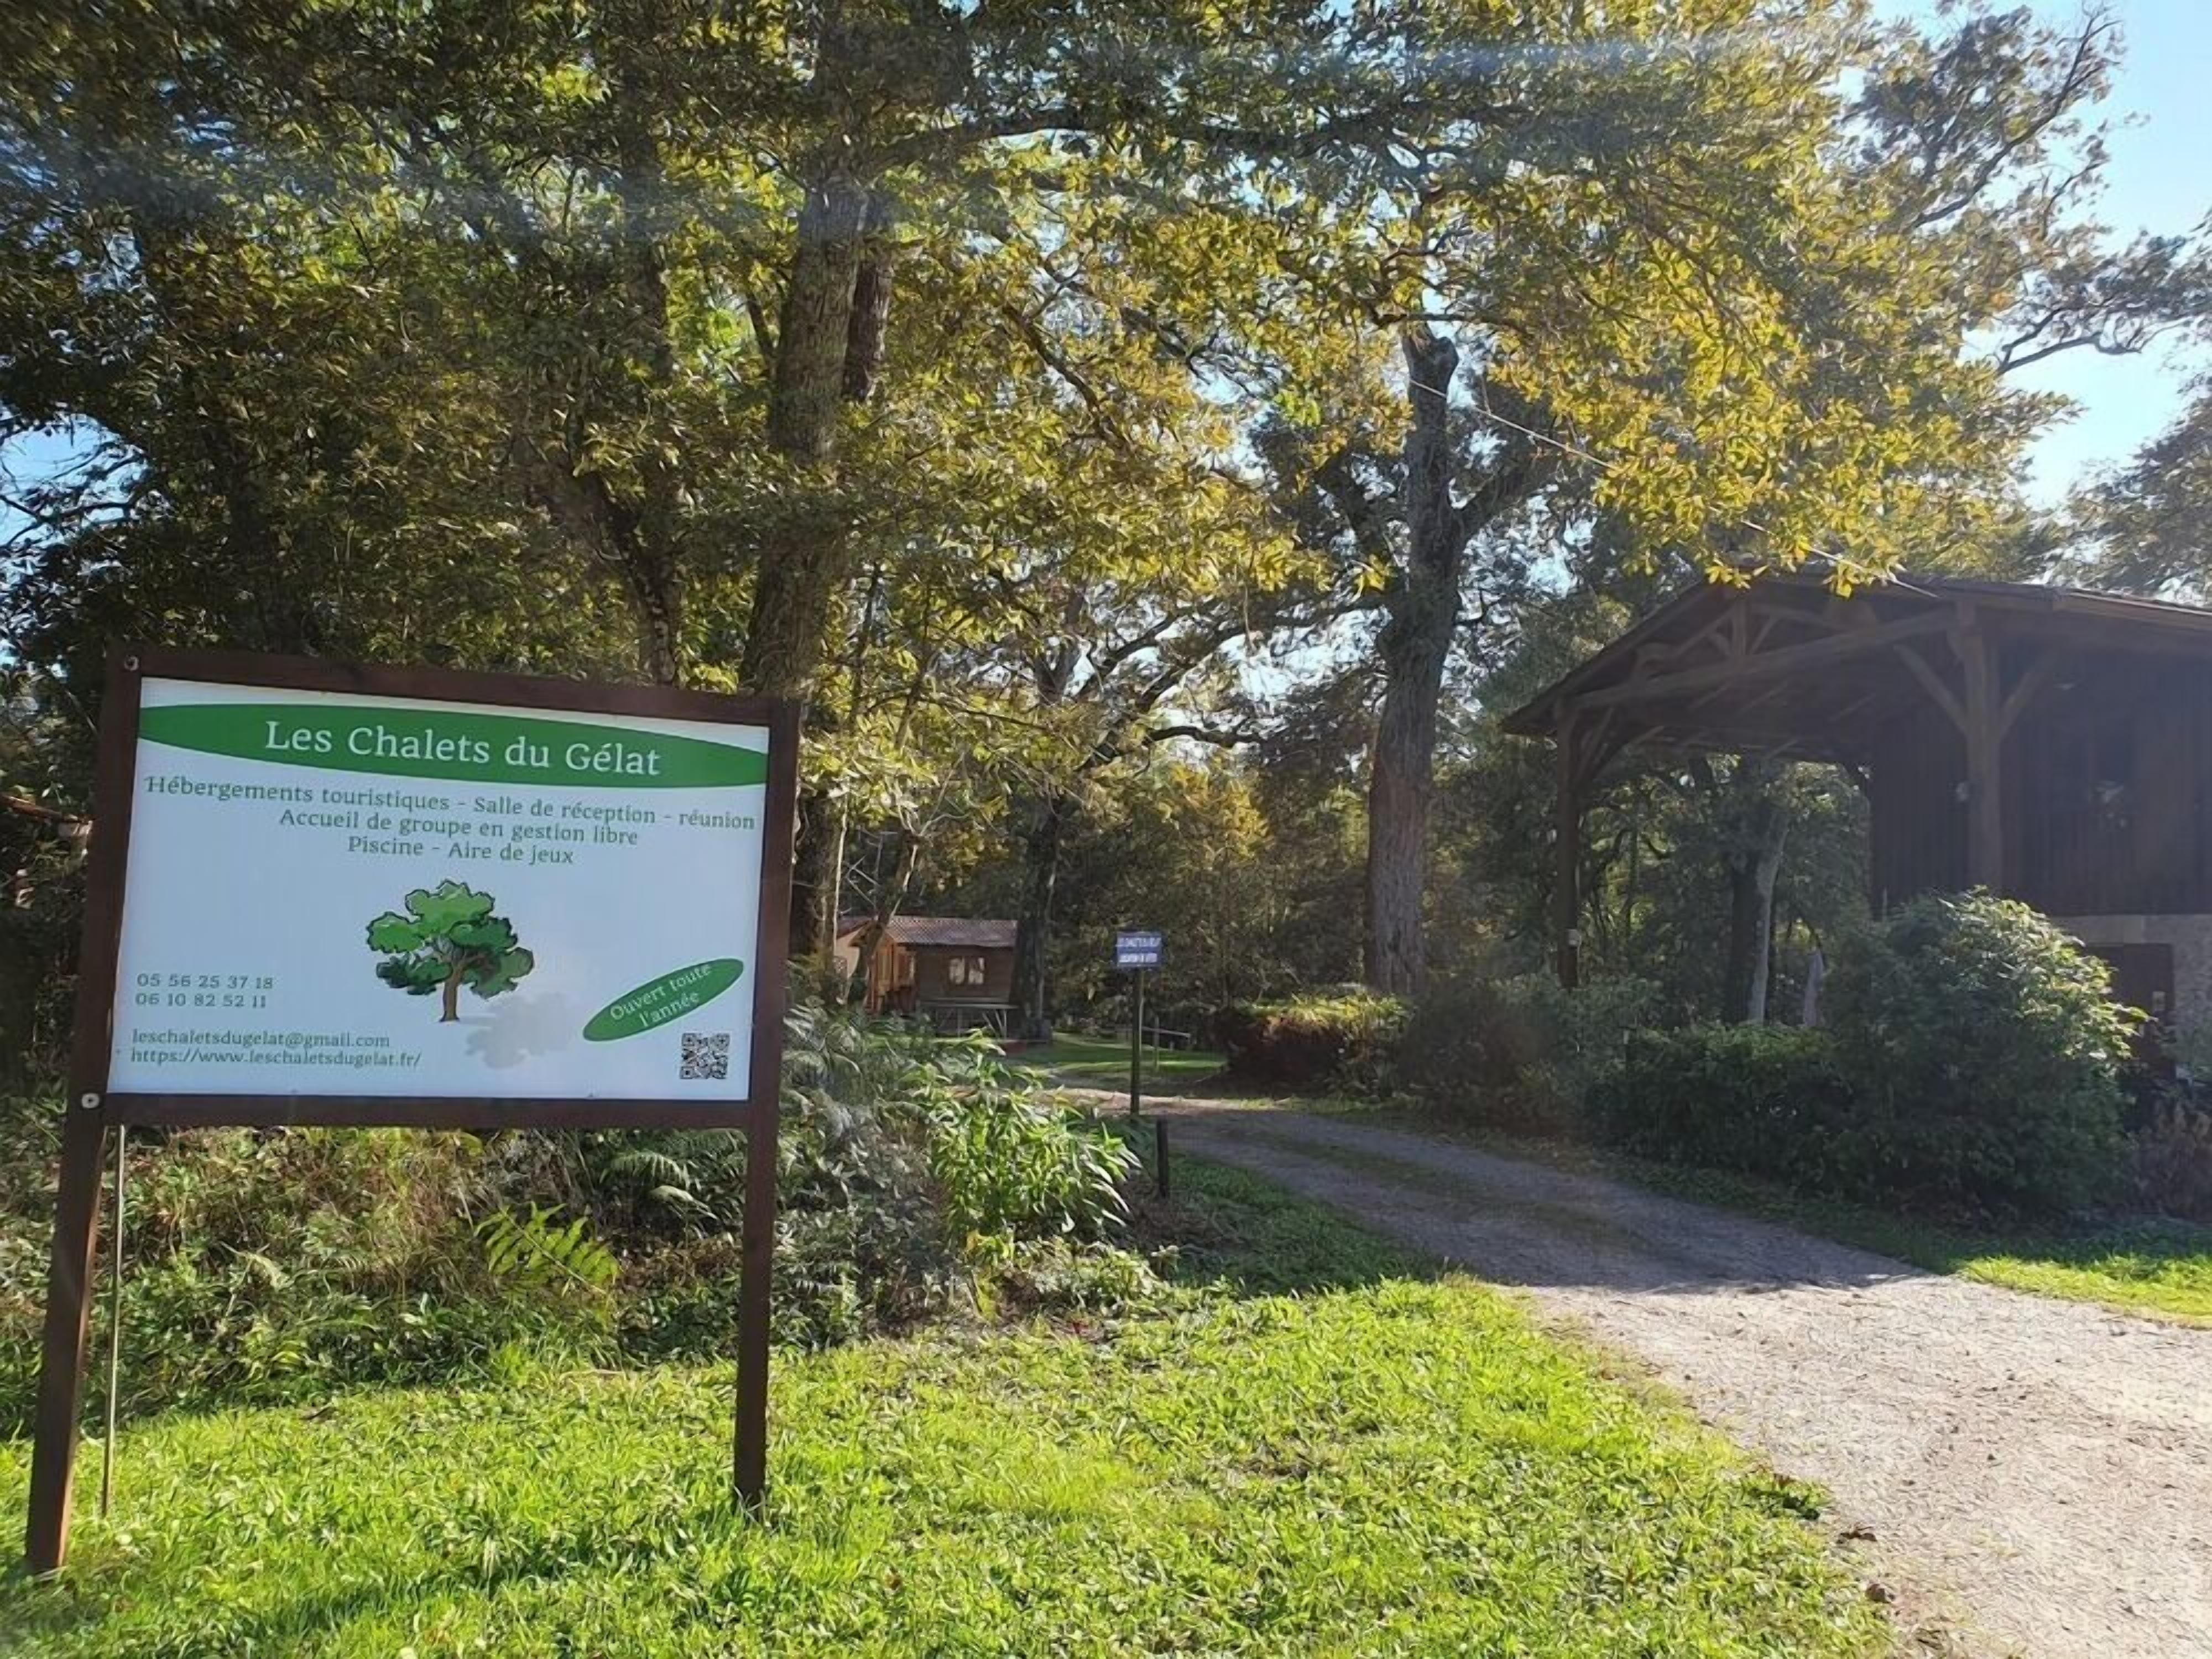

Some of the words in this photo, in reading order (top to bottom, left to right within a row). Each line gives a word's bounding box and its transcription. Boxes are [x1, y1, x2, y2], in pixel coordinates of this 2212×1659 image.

[265, 721, 332, 753] Les
[348, 726, 489, 764] Chalets
[504, 736, 549, 768] du
[565, 742, 662, 775] Gélat
[145, 775, 312, 802] Hébergements
[323, 789, 450, 812] touristiques
[473, 796, 522, 815] Salle
[530, 799, 553, 817] de
[561, 801, 655, 829] réception
[679, 811, 755, 830] réunion
[280, 809, 359, 828] Accueil
[367, 812, 392, 830] de
[399, 818, 471, 838] groupe
[480, 823, 503, 837] en
[511, 823, 584, 843] gestion
[593, 826, 638, 845] libre
[348, 836, 423, 855] Piscine
[448, 842, 492, 859] Aire
[500, 843, 523, 861] de
[529, 846, 574, 865] jeux
[137, 973, 160, 987] 05
[168, 974, 191, 987] 56
[199, 975, 220, 989] 25
[227, 975, 248, 989] 37
[256, 977, 273, 989] 18
[611, 986, 666, 1020] Ouvert
[669, 965, 712, 992] toute
[135, 993, 159, 1005] 06
[168, 993, 186, 1007] 10
[195, 994, 216, 1007] 82
[222, 995, 245, 1008] 52
[253, 995, 266, 1009] 11
[639, 992, 700, 1027] l'année
[133, 1029, 390, 1049] leschaletsdugelat@gmail.com
[131, 1047, 421, 1068] https://www.leschaletsdugelat.fr/
